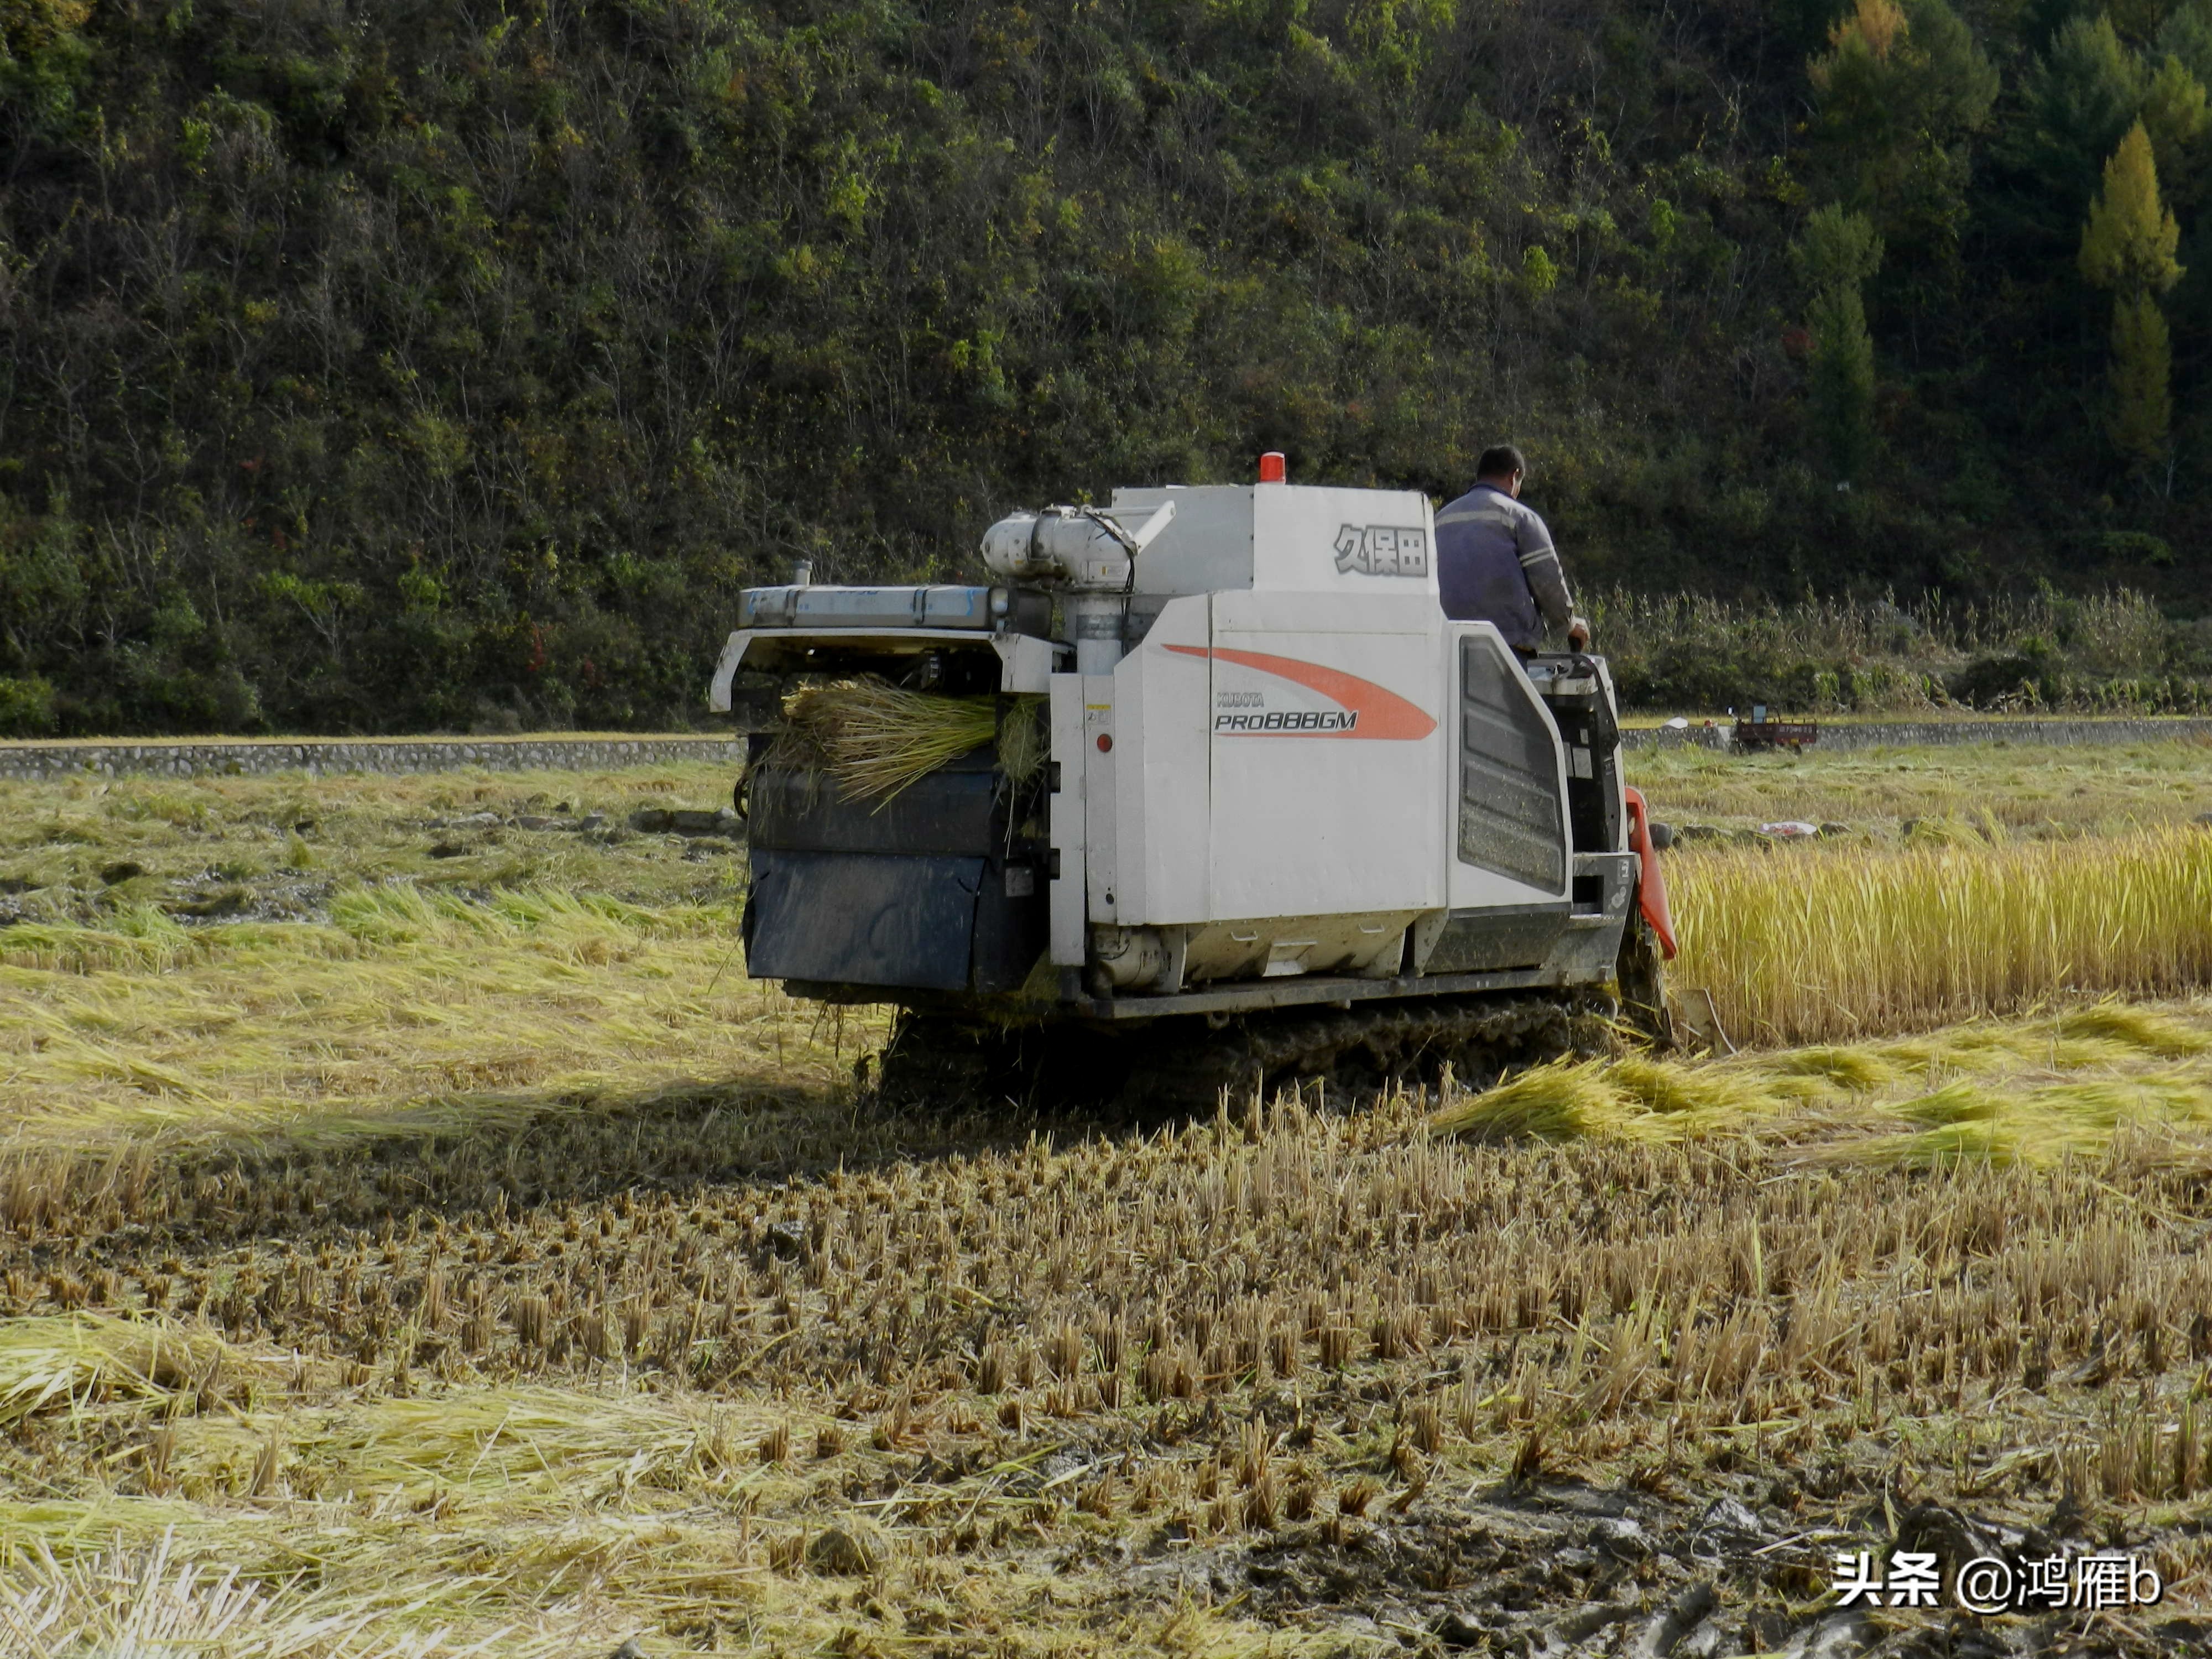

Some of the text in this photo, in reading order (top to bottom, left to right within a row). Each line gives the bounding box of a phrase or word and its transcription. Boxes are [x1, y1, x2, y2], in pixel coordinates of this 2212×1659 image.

[1333, 524, 1428, 577] 久保田
[1217, 692, 1264, 707] KUBOTA
[1215, 711, 1358, 730] PRO888GM
